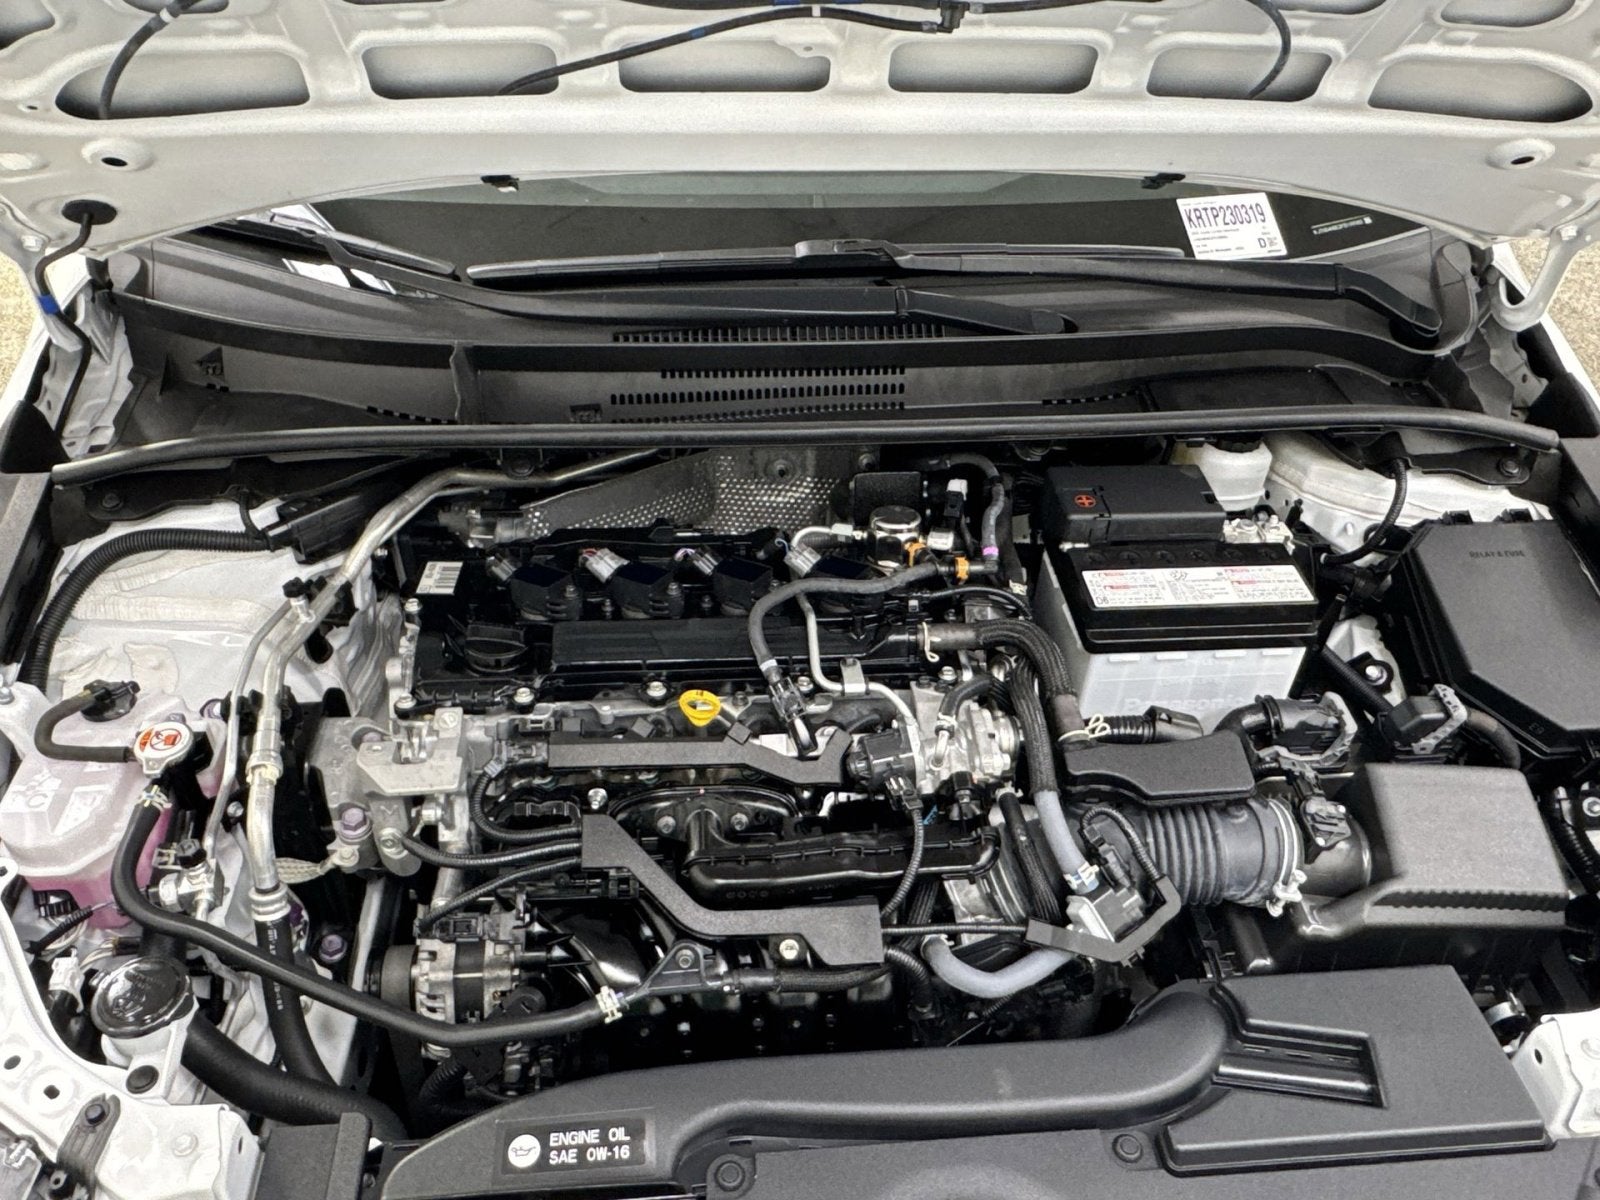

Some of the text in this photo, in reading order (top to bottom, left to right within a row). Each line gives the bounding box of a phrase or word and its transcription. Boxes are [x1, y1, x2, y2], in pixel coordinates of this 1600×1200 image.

[1184, 202, 1266, 229] KRTP230319
[1257, 237, 1267, 249] D
[549, 1127, 631, 1146] ENGINE OIL
[549, 1149, 578, 1165] SAE
